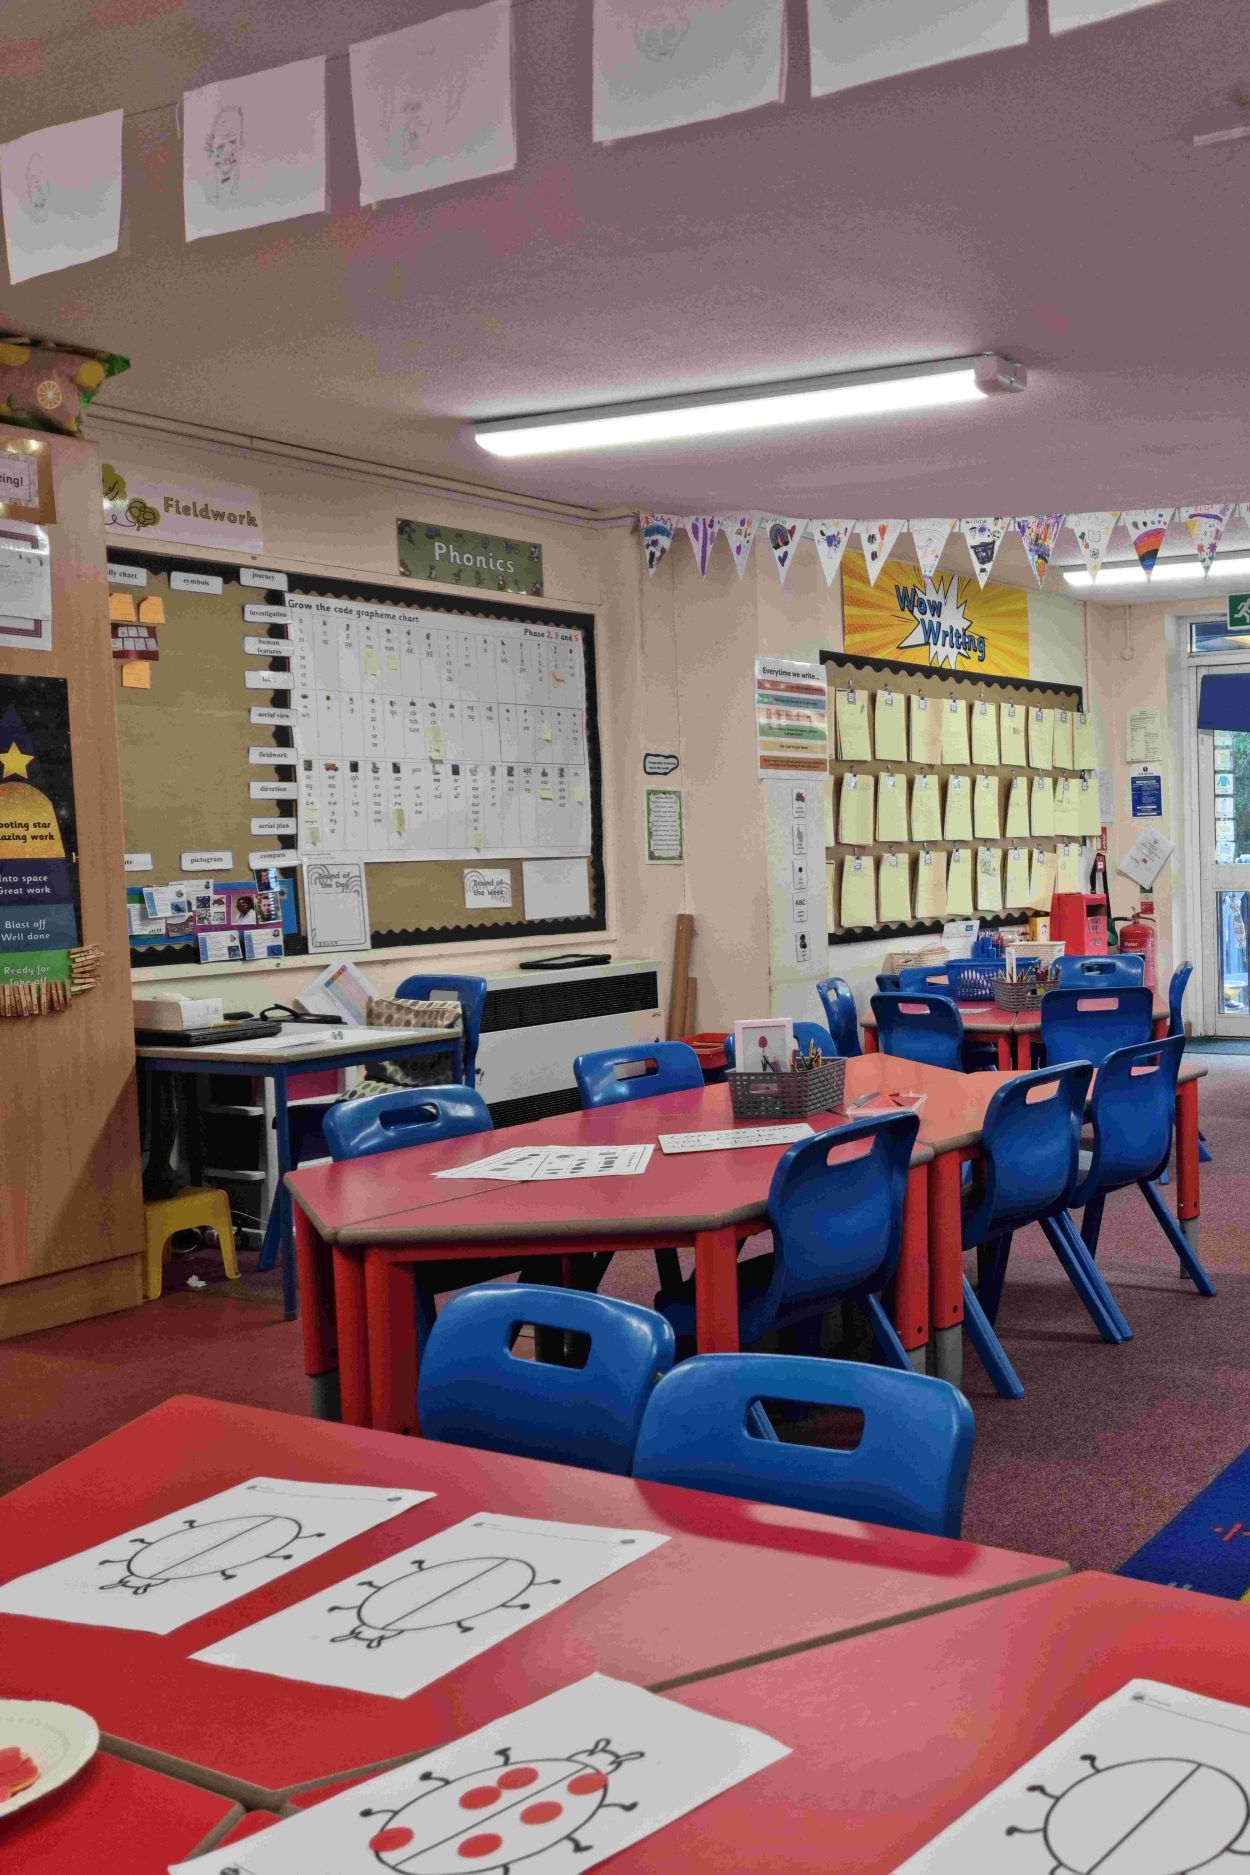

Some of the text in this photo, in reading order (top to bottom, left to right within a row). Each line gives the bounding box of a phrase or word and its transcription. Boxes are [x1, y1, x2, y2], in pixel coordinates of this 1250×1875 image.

[163, 496, 258, 527] Fieldwork
[434, 541, 515, 573] Phonics
[119, 569, 137, 579] chart
[252, 571, 275, 582] journey
[183, 577, 210, 587] symbols
[894, 584, 942, 618] Wow
[249, 609, 287, 618] investigation
[288, 600, 419, 623] Grow the code grapheme chart
[524, 628, 545, 638] Phase
[555, 632, 559, 640] 3
[920, 617, 986, 662] Writing
[762, 666, 791, 677] Everytime
[31, 832, 55, 841] work
[190, 856, 223, 865] pictogram
[260, 852, 286, 860] compass
[22, 875, 48, 884] space
[318, 872, 340, 880] Sound
[473, 879, 504, 888] Sound of
[473, 888, 504, 896] the Week
[5, 920, 46, 930] Blast off
[1, 932, 50, 941] Well done
[4, 966, 50, 976] Ready for
